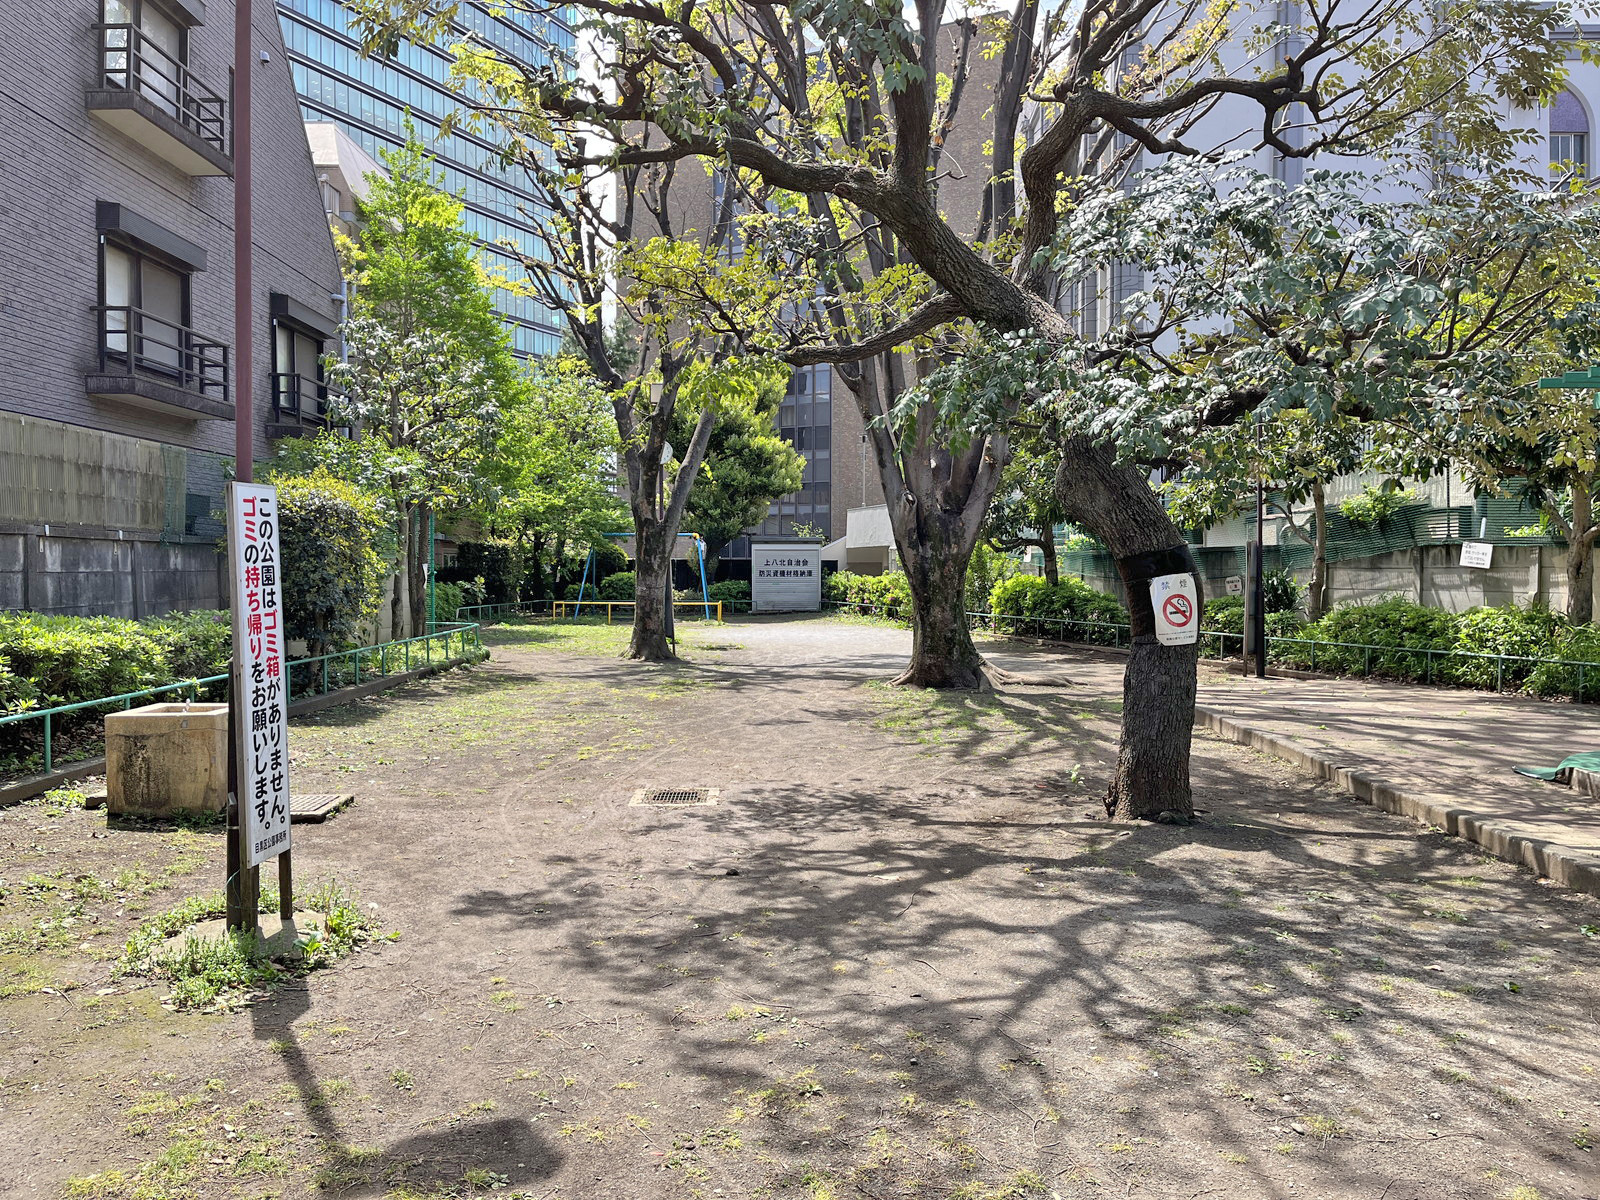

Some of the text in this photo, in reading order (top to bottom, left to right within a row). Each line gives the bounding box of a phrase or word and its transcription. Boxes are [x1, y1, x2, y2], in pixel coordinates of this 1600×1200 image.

[764, 558, 809, 567] 上八北自治会
[242, 496, 271, 829] ゴミの持ち帰りをお願いします。
[259, 498, 286, 824] この公園はゴミ箱がありません。
[255, 830, 287, 854] 目黒区公園事務所
